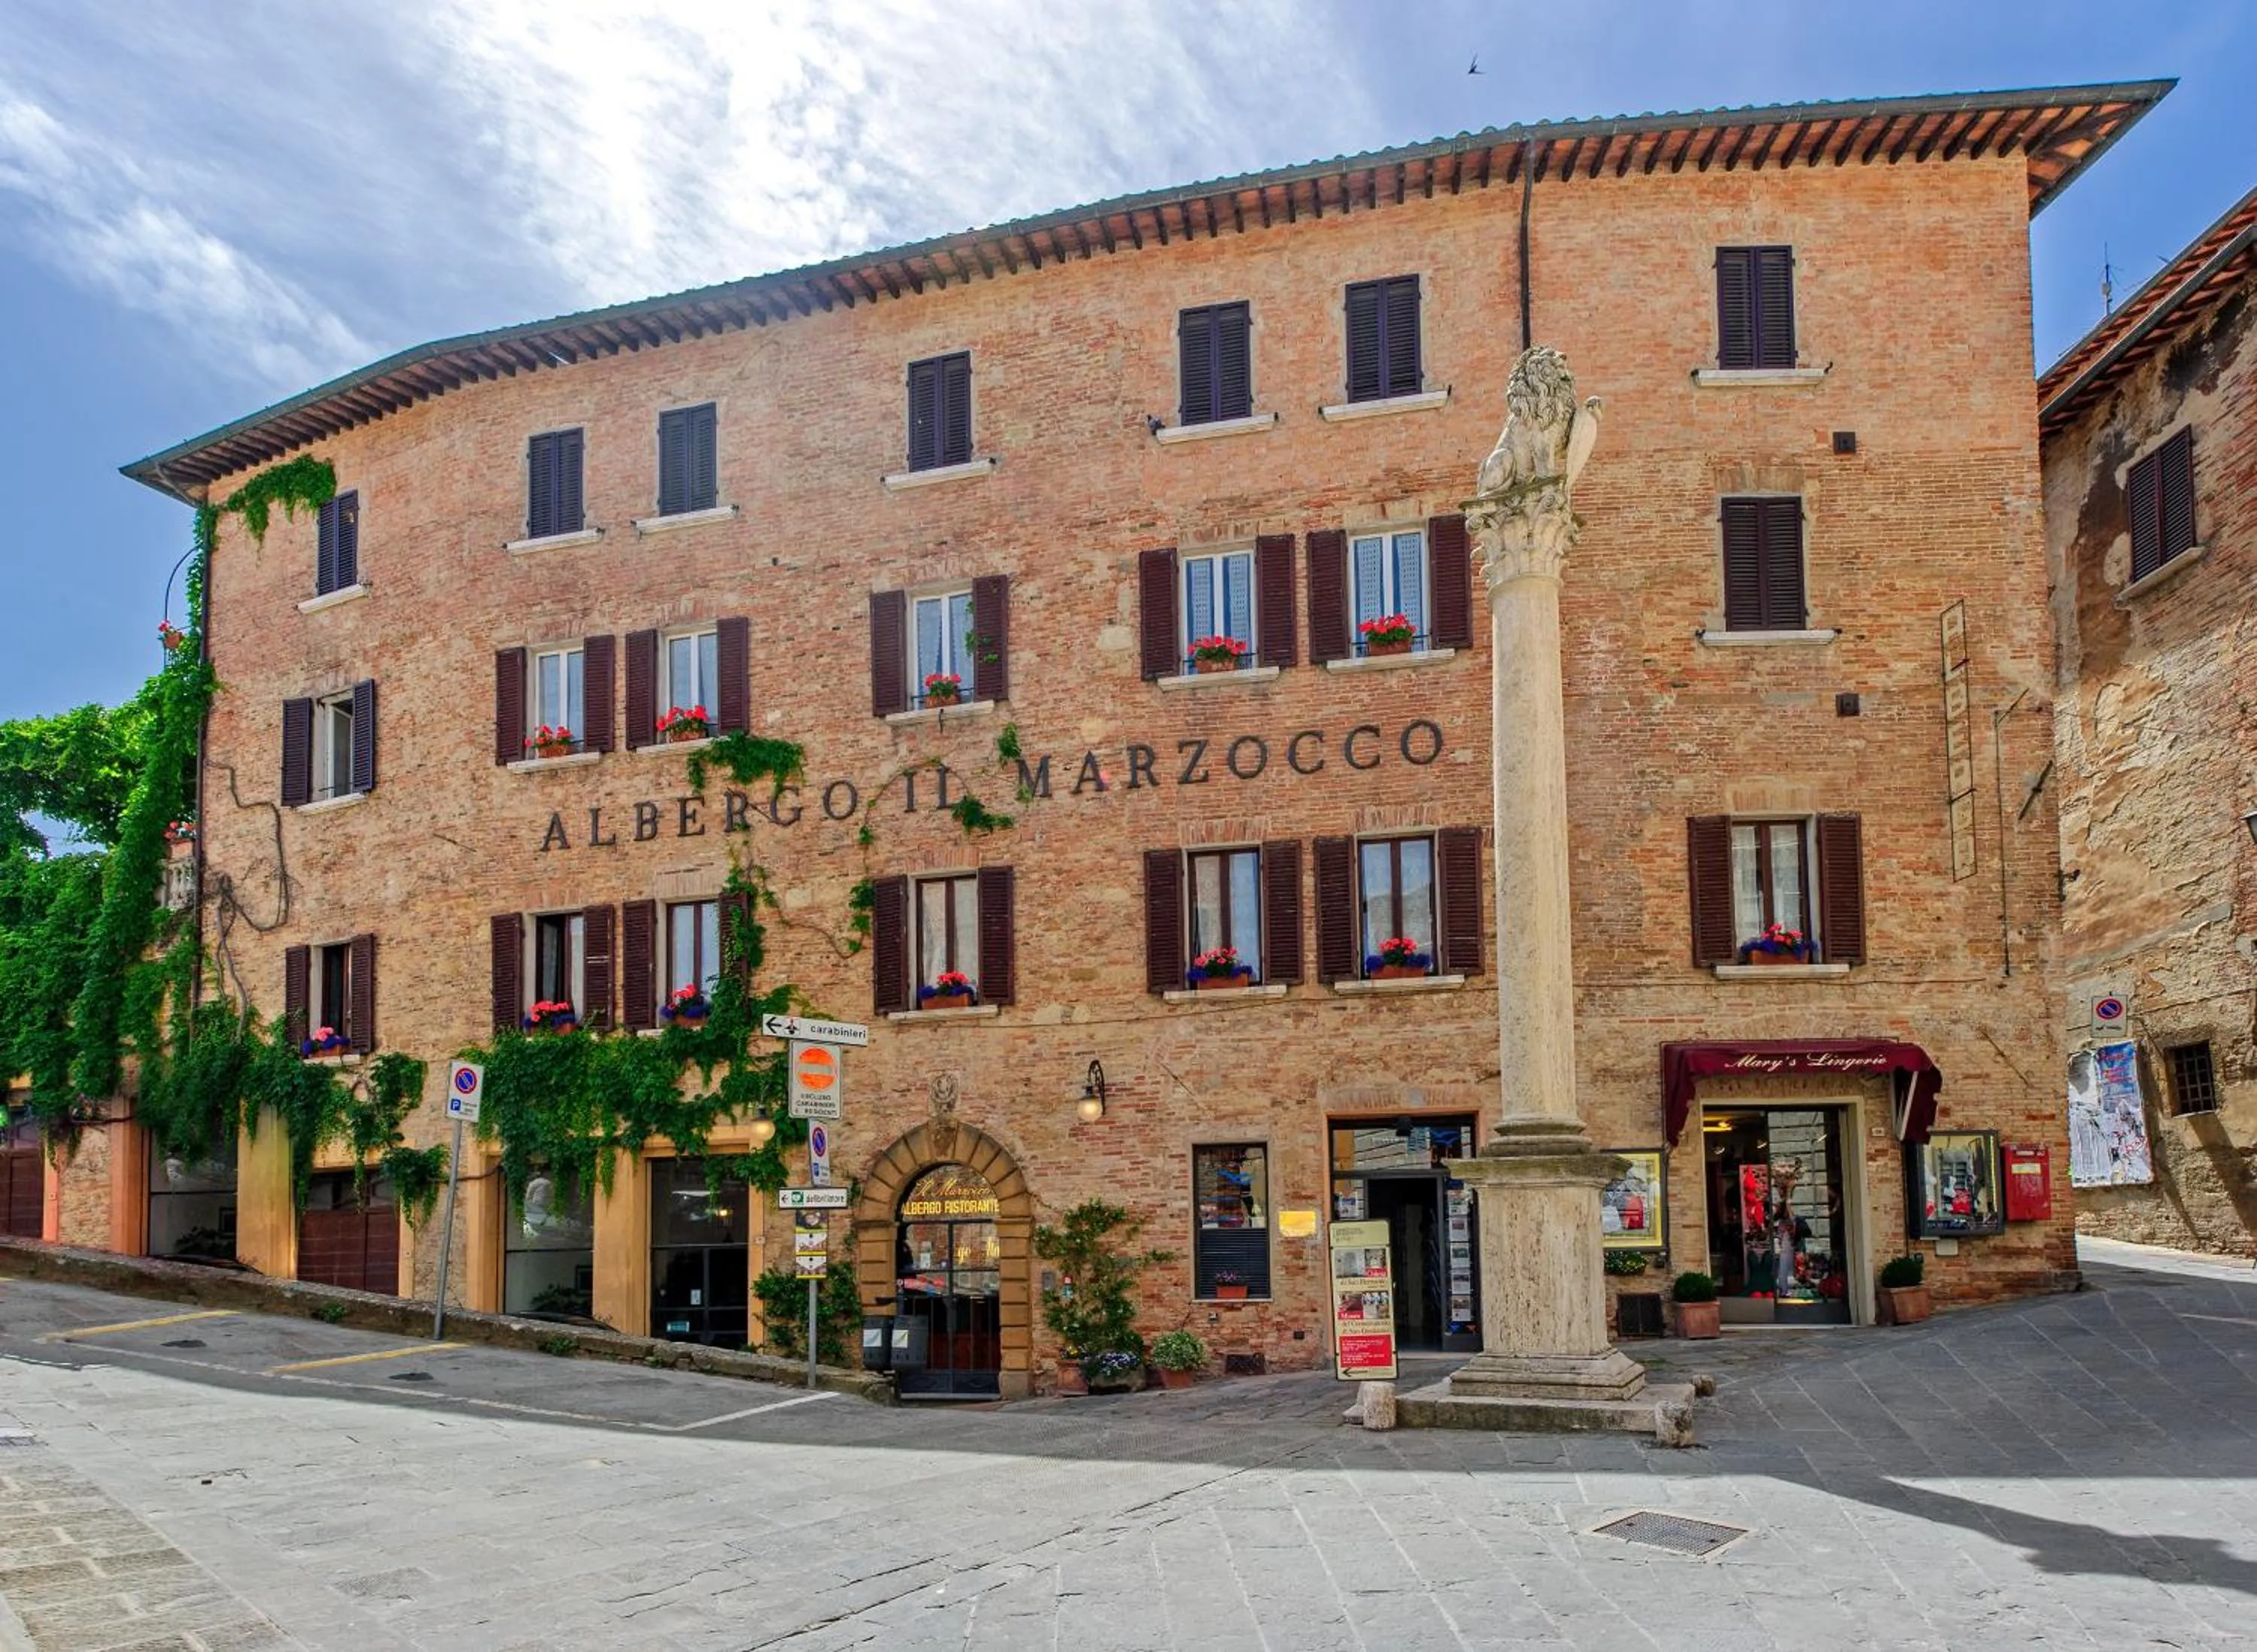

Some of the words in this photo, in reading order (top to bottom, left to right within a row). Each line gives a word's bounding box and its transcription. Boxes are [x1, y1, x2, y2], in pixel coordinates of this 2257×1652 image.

[539, 779, 858, 852] ALBERGO
[903, 762, 955, 813] IL
[1016, 718, 1444, 799] MARZOCCO
[810, 1025, 866, 1038] carabinieri
[1724, 1053, 1797, 1072] Mary's
[1806, 1052, 1888, 1071] Lingerie
[944, 1198, 999, 1213] RISTORANTE
